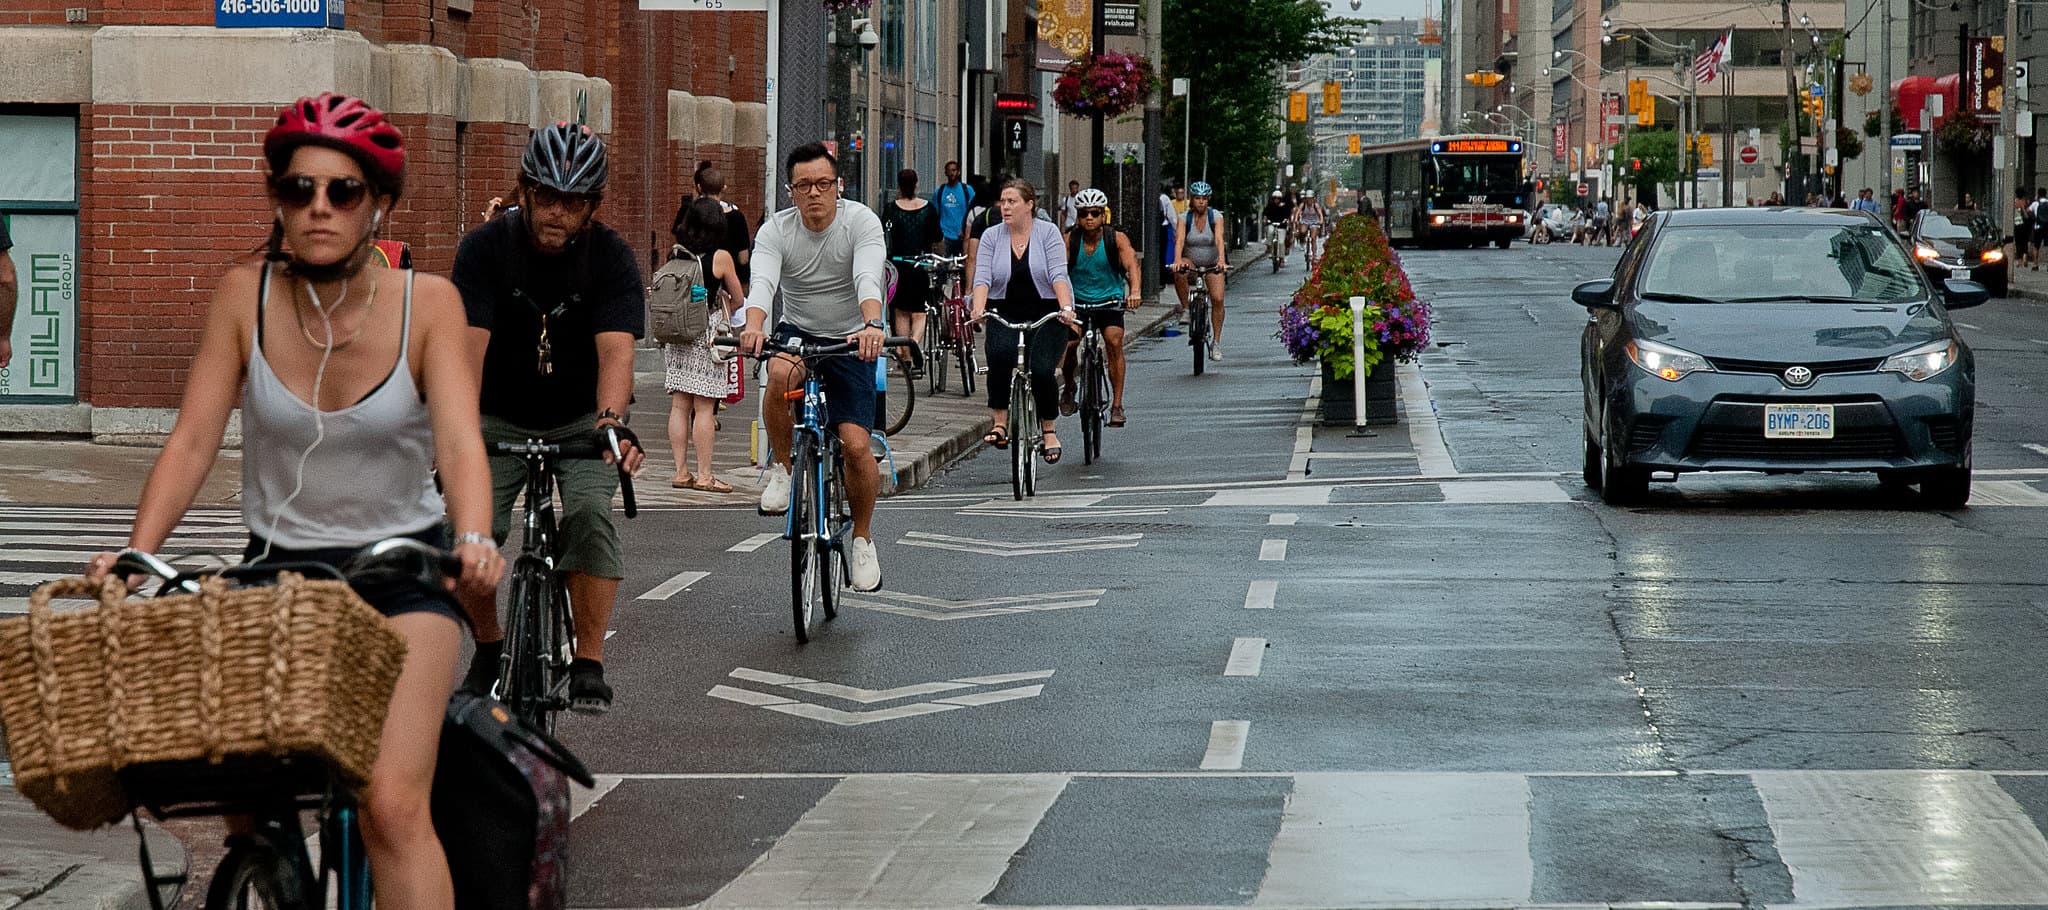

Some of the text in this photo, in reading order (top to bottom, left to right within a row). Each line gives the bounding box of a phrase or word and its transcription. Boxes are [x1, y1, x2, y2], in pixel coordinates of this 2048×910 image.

[220, 0, 320, 14] 416-506-1000
[1973, 42, 1983, 110] entertainment
[1013, 121, 1022, 149] ATM
[1556, 125, 1564, 151] LEASE
[62, 254, 72, 300] GROUP
[30, 254, 60, 387] GILLAM
[0, 368, 10, 397] GRO
[728, 357, 739, 395] Root
[1768, 413, 1830, 430] BYMP 206
